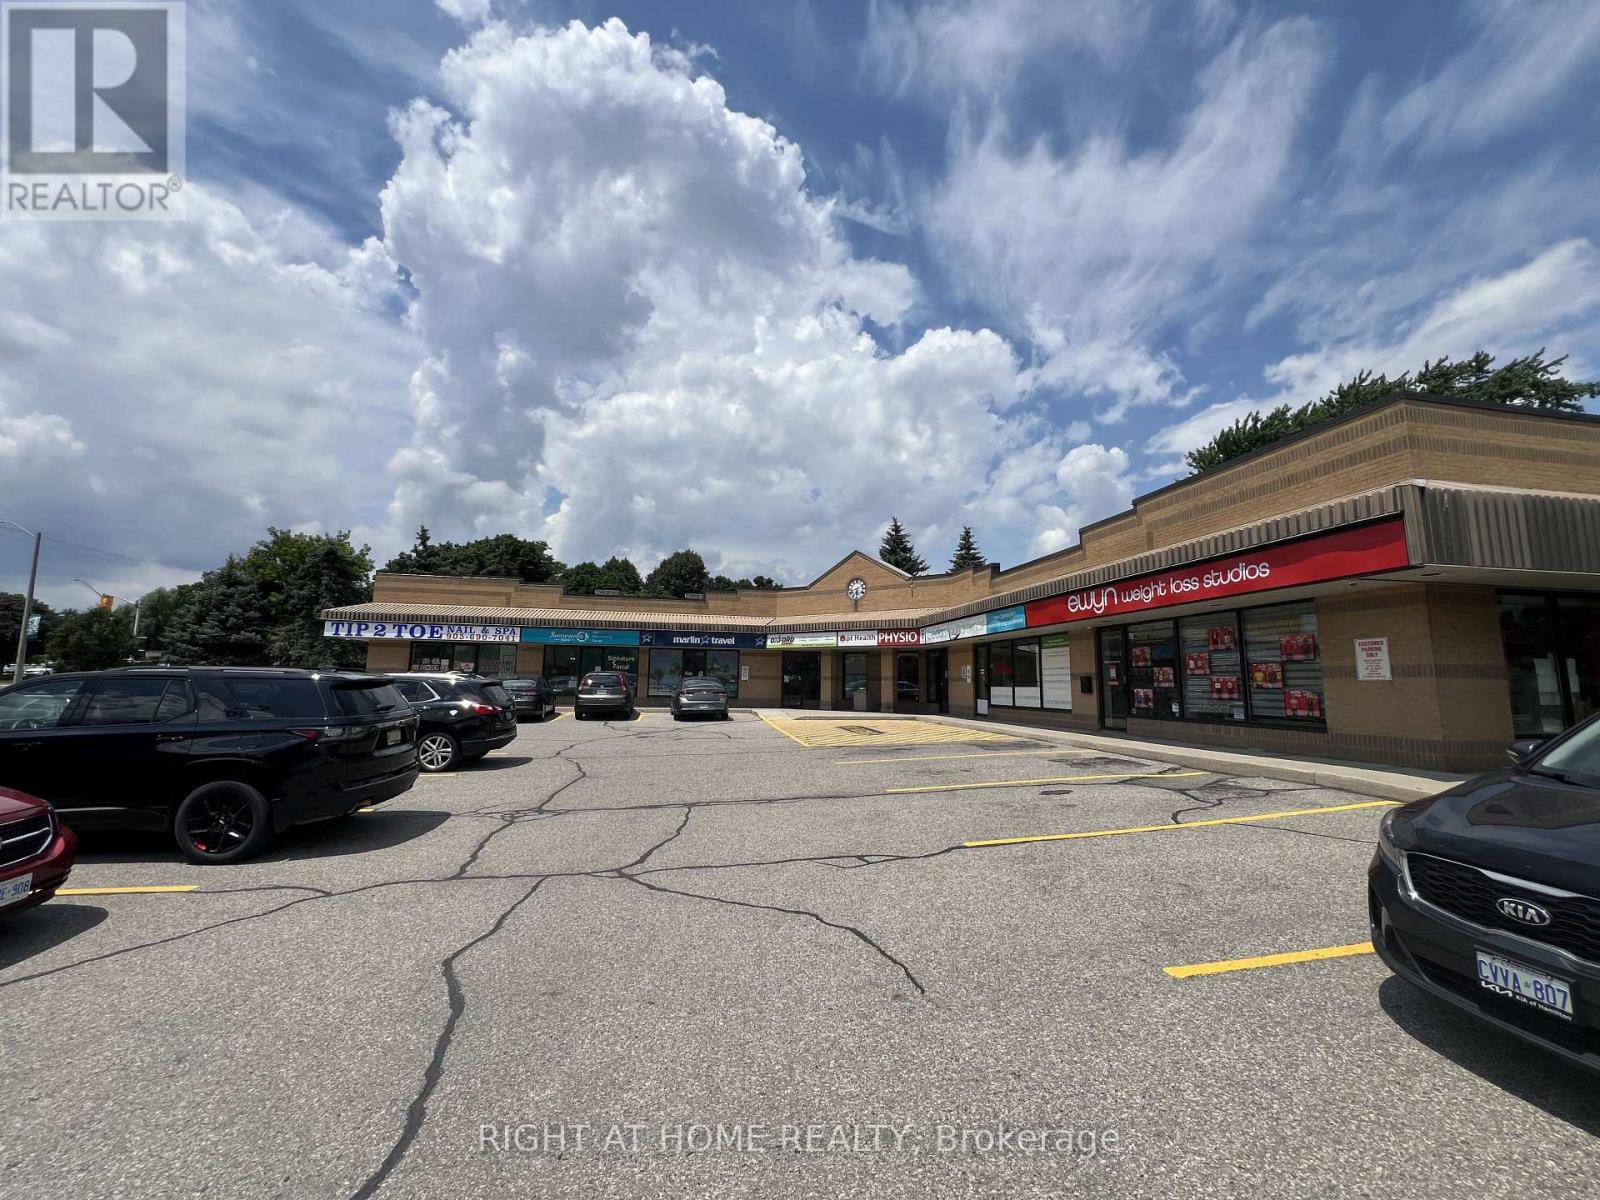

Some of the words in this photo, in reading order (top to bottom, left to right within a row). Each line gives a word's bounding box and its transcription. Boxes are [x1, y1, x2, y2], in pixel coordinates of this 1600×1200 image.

[1068, 586, 1117, 614] ewyn
[1121, 582, 1167, 603] weight
[1169, 576, 1199, 594] loss
[1203, 562, 1270, 588] studios
[331, 622, 369, 636] TIP
[374, 624, 387, 637] 2
[392, 624, 443, 639] TOE
[447, 626, 475, 634] NAIL
[481, 626, 489, 634] &
[495, 627, 516, 635] SPA
[879, 632, 918, 643] PHYSIO
[673, 635, 700, 644] marlin
[711, 637, 735, 645] travel
[1503, 901, 1540, 923] KIA
[1533, 979, 1568, 1009] 807
